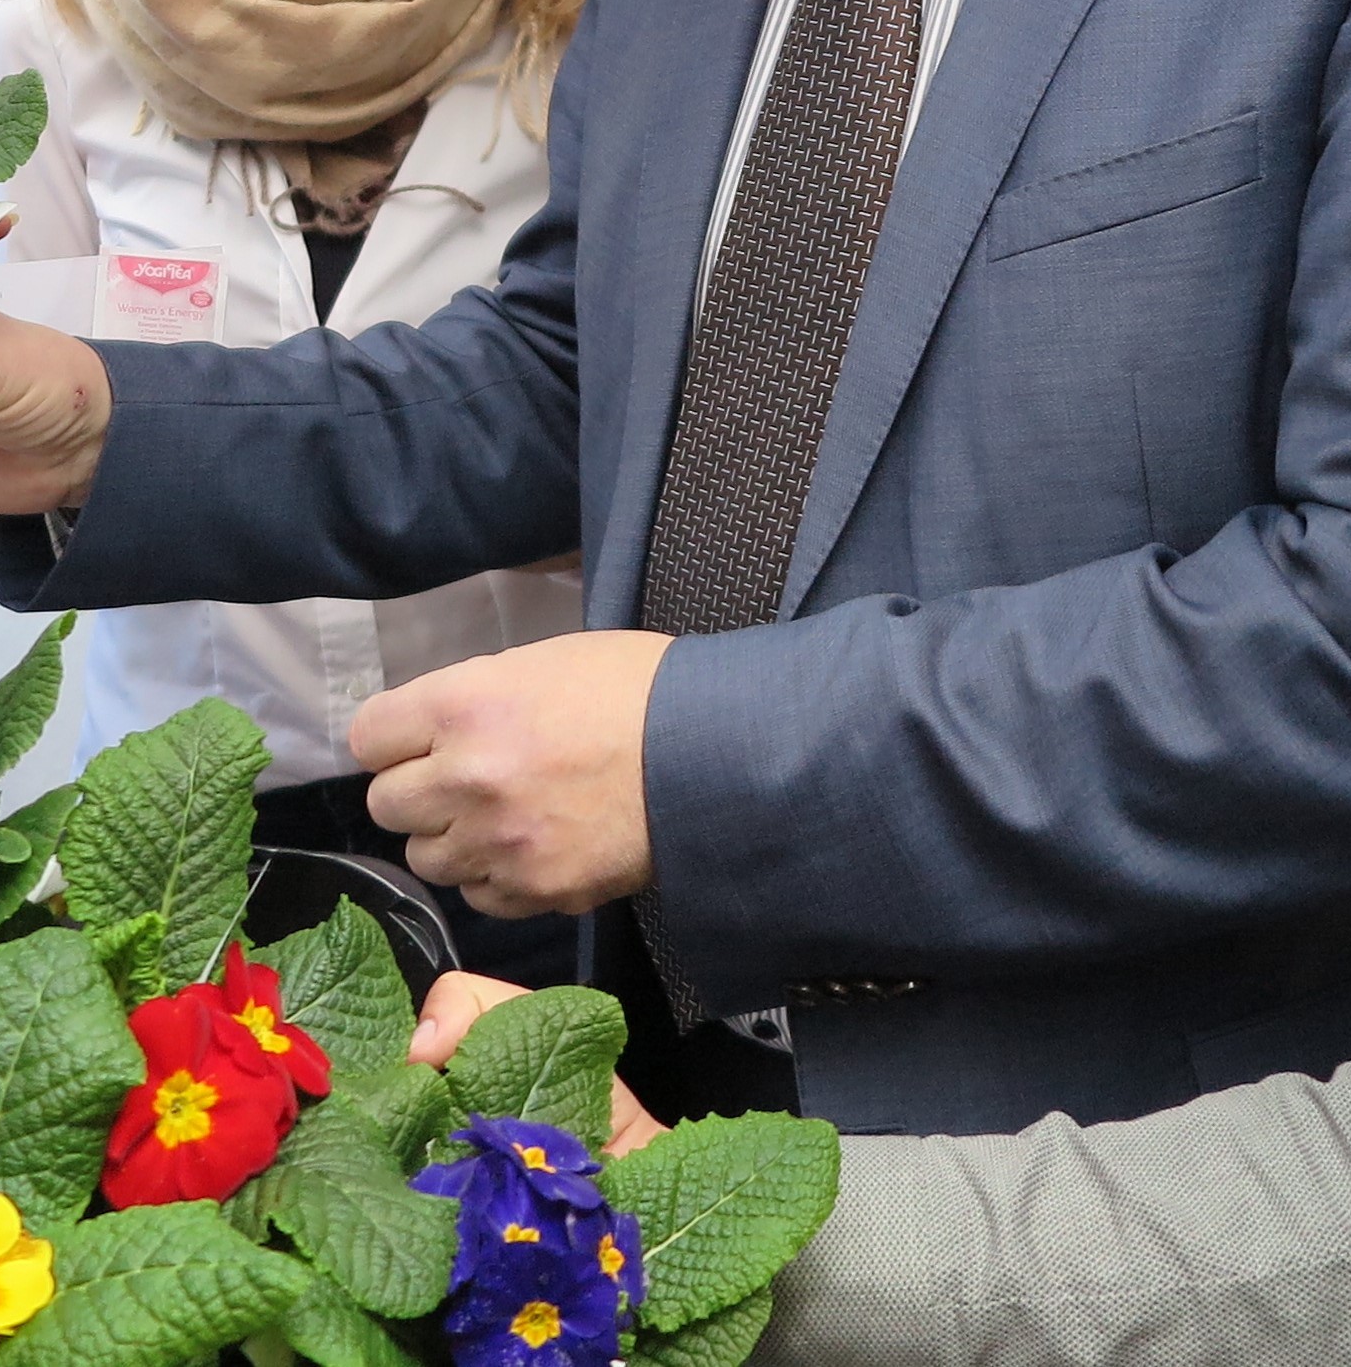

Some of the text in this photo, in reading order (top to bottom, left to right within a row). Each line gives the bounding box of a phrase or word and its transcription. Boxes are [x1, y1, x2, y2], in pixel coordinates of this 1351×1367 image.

[133, 262, 192, 280] YOGI TEA
[168, 307, 205, 321] Energy
